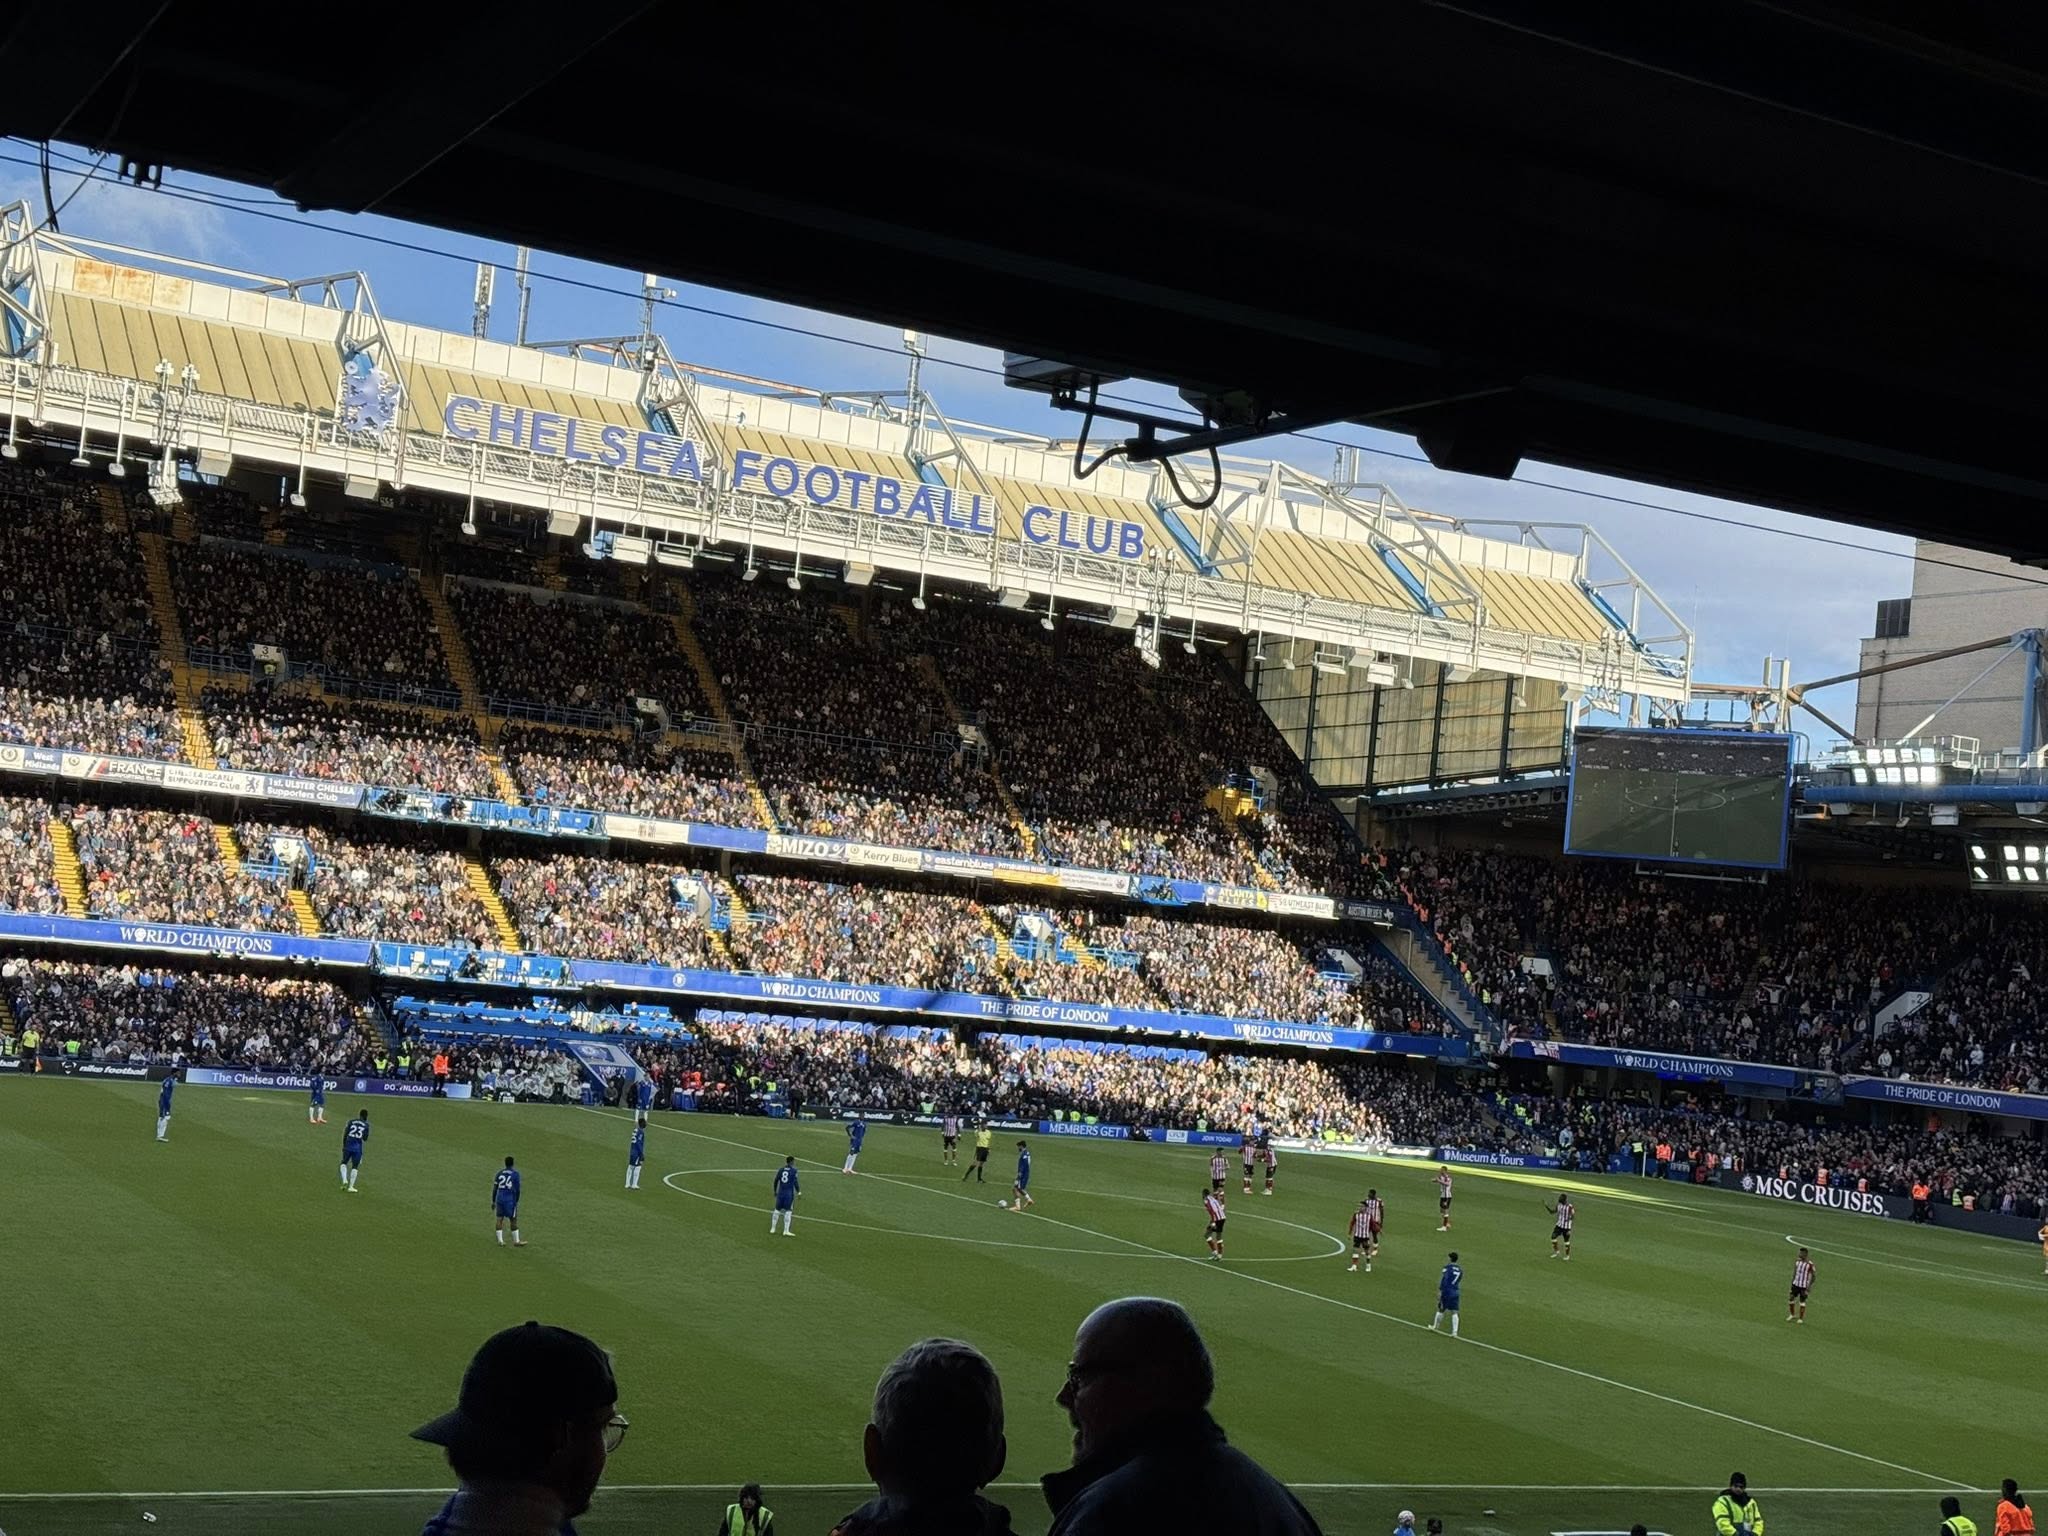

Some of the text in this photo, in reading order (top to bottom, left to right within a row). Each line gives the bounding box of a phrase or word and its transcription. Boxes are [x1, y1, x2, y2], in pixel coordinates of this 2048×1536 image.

[444, 395, 1145, 559] CHELSEA FOOTBALL CLUB
[33, 751, 54, 762] West
[25, 759, 60, 771] Midlands
[109, 761, 161, 777] FRANCE
[167, 775, 218, 788] SUPPORTERS
[285, 779, 316, 791] ULSTER
[316, 783, 355, 795] CHELSEA
[266, 786, 338, 802] Supporters Club
[282, 840, 290, 850] 3
[782, 837, 829, 858] MIZO
[863, 849, 919, 865] Kerry Blues
[119, 926, 272, 953] WORLD CHAMPIONS
[760, 981, 880, 1004] WORLD CHAMPIONS
[980, 1000, 1109, 1024] THE PRIDE OF LONDON
[1233, 1023, 1334, 1044] WORLD CHAMPIONS
[104, 1065, 149, 1076] football
[1613, 1054, 1734, 1077] WORLD CHAMPIONS
[211, 1072, 232, 1083] The
[234, 1073, 274, 1085] Chelsea
[276, 1075, 312, 1087] Officia
[1884, 1084, 2001, 1109] THE PRIDE OF LONDON
[349, 1124, 365, 1139] 23
[1049, 1122, 1099, 1137] MEMBERS
[1099, 1125, 1125, 1138] GET
[1450, 1150, 1525, 1167] Museum & Tours
[498, 1175, 513, 1189] 24
[781, 1170, 789, 1184] 8
[1755, 1175, 1884, 1215] MSC CRUISES
[1451, 1271, 1461, 1285] 7
